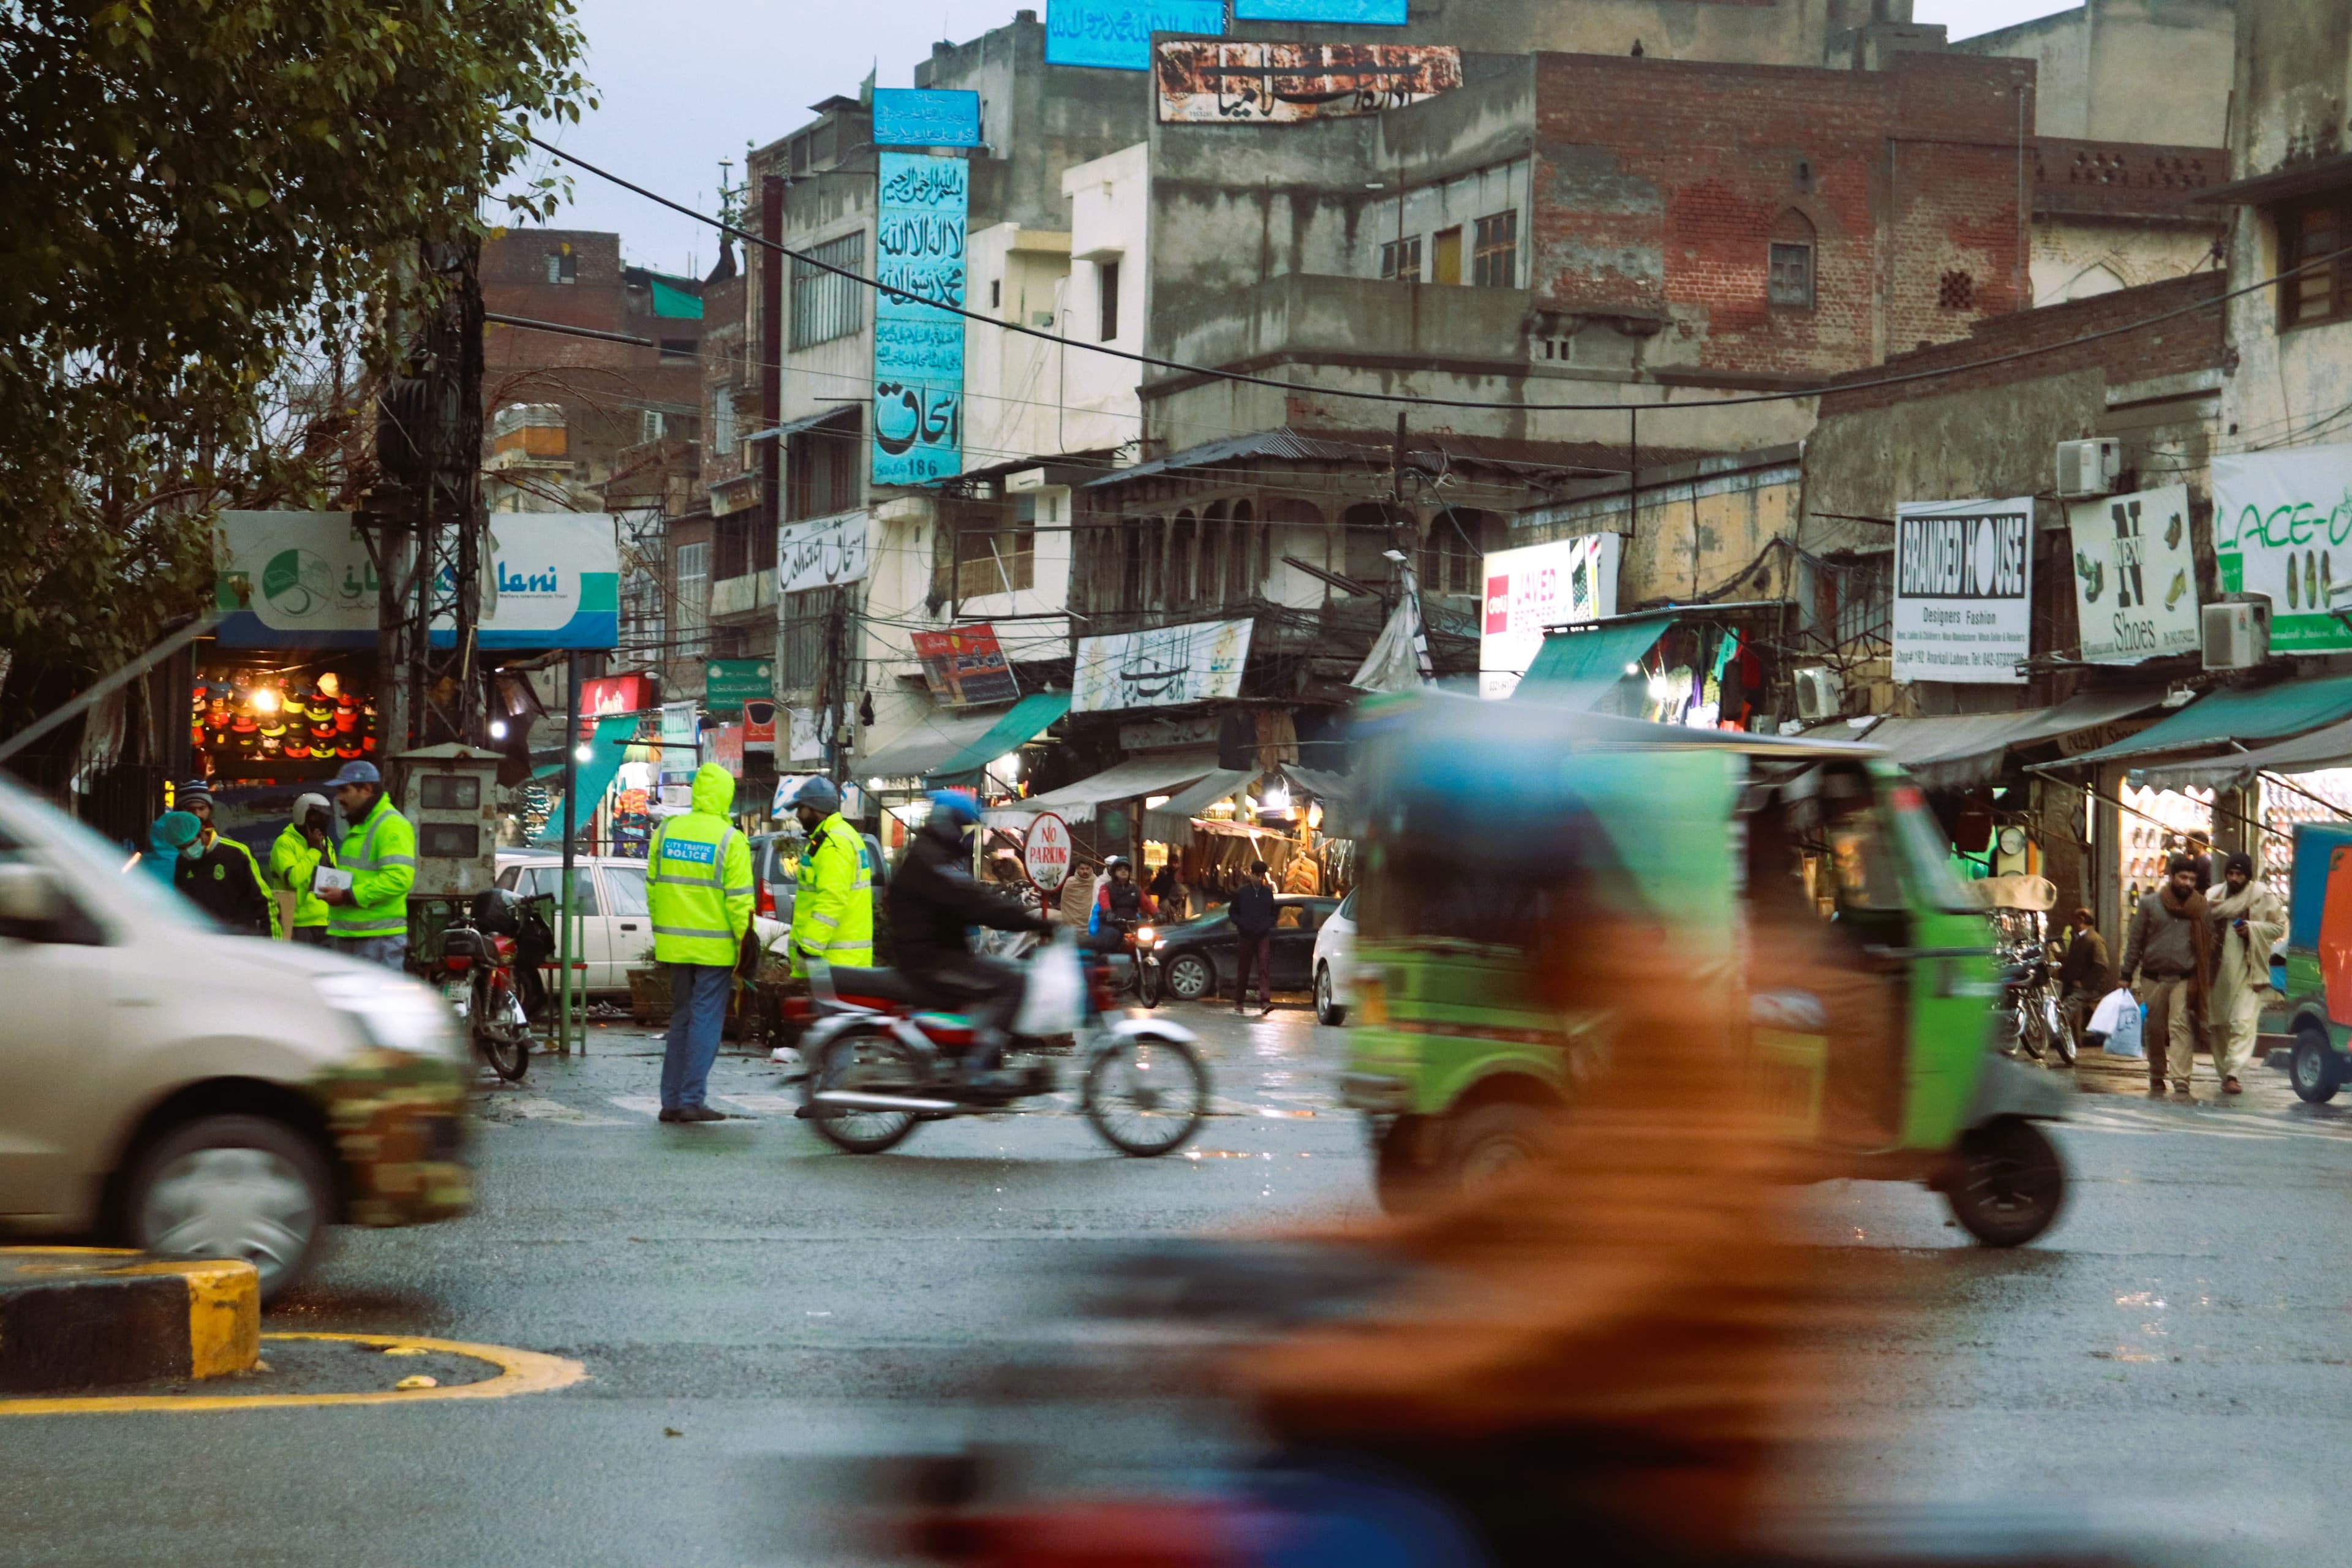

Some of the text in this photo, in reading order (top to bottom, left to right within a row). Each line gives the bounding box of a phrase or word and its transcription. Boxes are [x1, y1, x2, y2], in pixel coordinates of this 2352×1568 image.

[909, 459, 938, 476] 186
[780, 529, 822, 590] Eshaq
[1902, 516, 2024, 596] BRANDED HOUSE
[2112, 533, 2146, 568] NEW
[1517, 568, 1556, 606] JAVED
[1923, 607, 1996, 626] Designers Fashion
[2113, 611, 2156, 652] Shoes
[1927, 651, 1948, 665] Anarkali
[1041, 827, 1057, 843] NO
[667, 849, 707, 860] POLICE
[684, 843, 711, 853] TRAFFIC
[1030, 846, 1068, 864] PARKING
